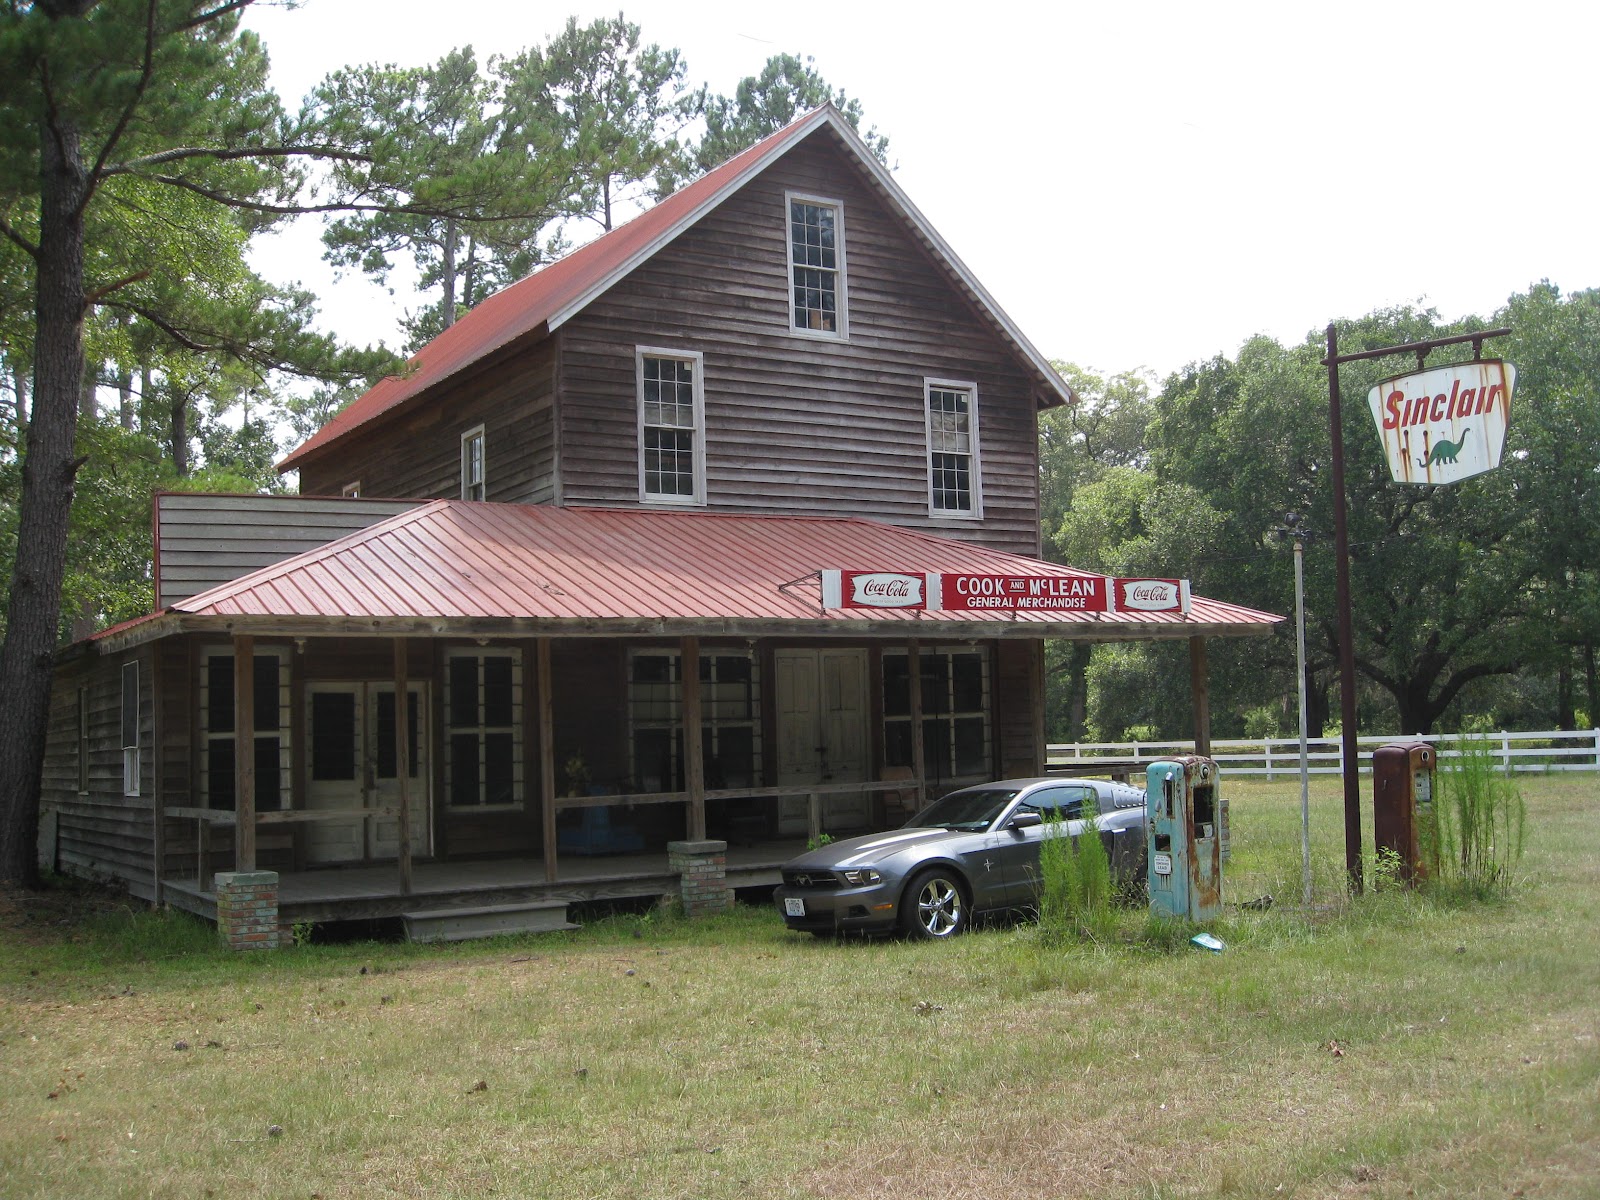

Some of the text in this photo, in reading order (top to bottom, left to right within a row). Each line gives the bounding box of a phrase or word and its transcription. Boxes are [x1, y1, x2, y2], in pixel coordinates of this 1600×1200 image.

[1382, 380, 1505, 430] Sinclair
[956, 576, 1006, 596] COOK
[1010, 581, 1025, 590] AND
[966, 596, 1086, 608] GENERAL MERCHANDISE
